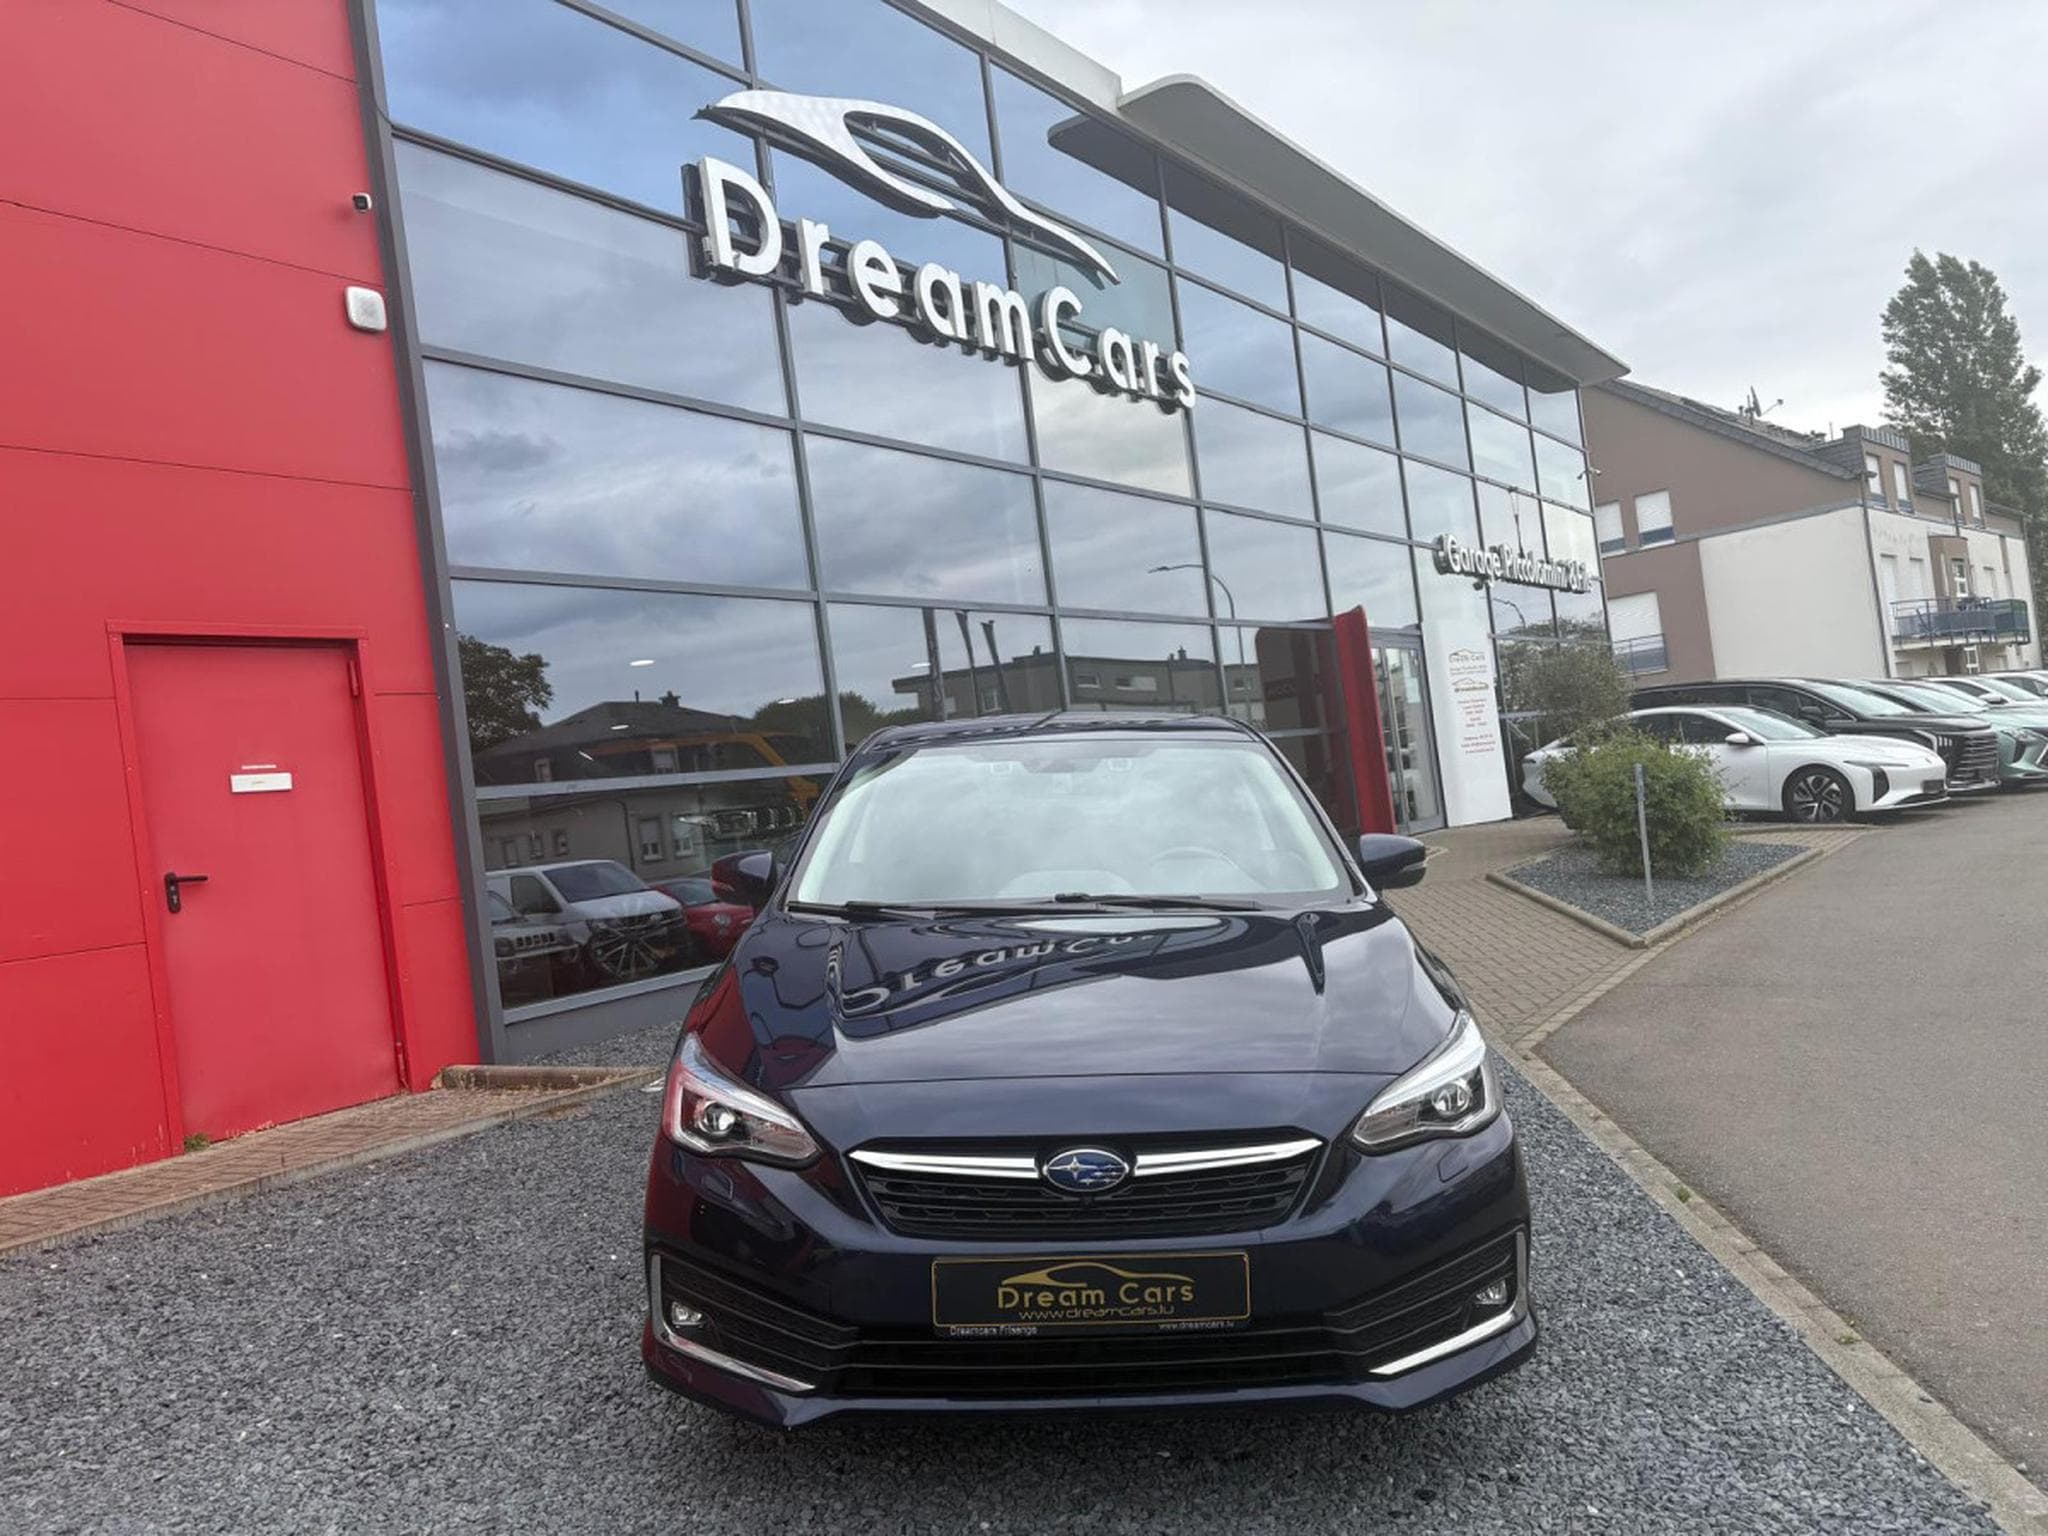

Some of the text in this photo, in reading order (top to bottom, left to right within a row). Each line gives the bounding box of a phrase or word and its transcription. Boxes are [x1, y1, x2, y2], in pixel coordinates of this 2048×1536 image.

[1446, 534, 1502, 588] Garage
[997, 1282, 1195, 1309] Dream Cars
